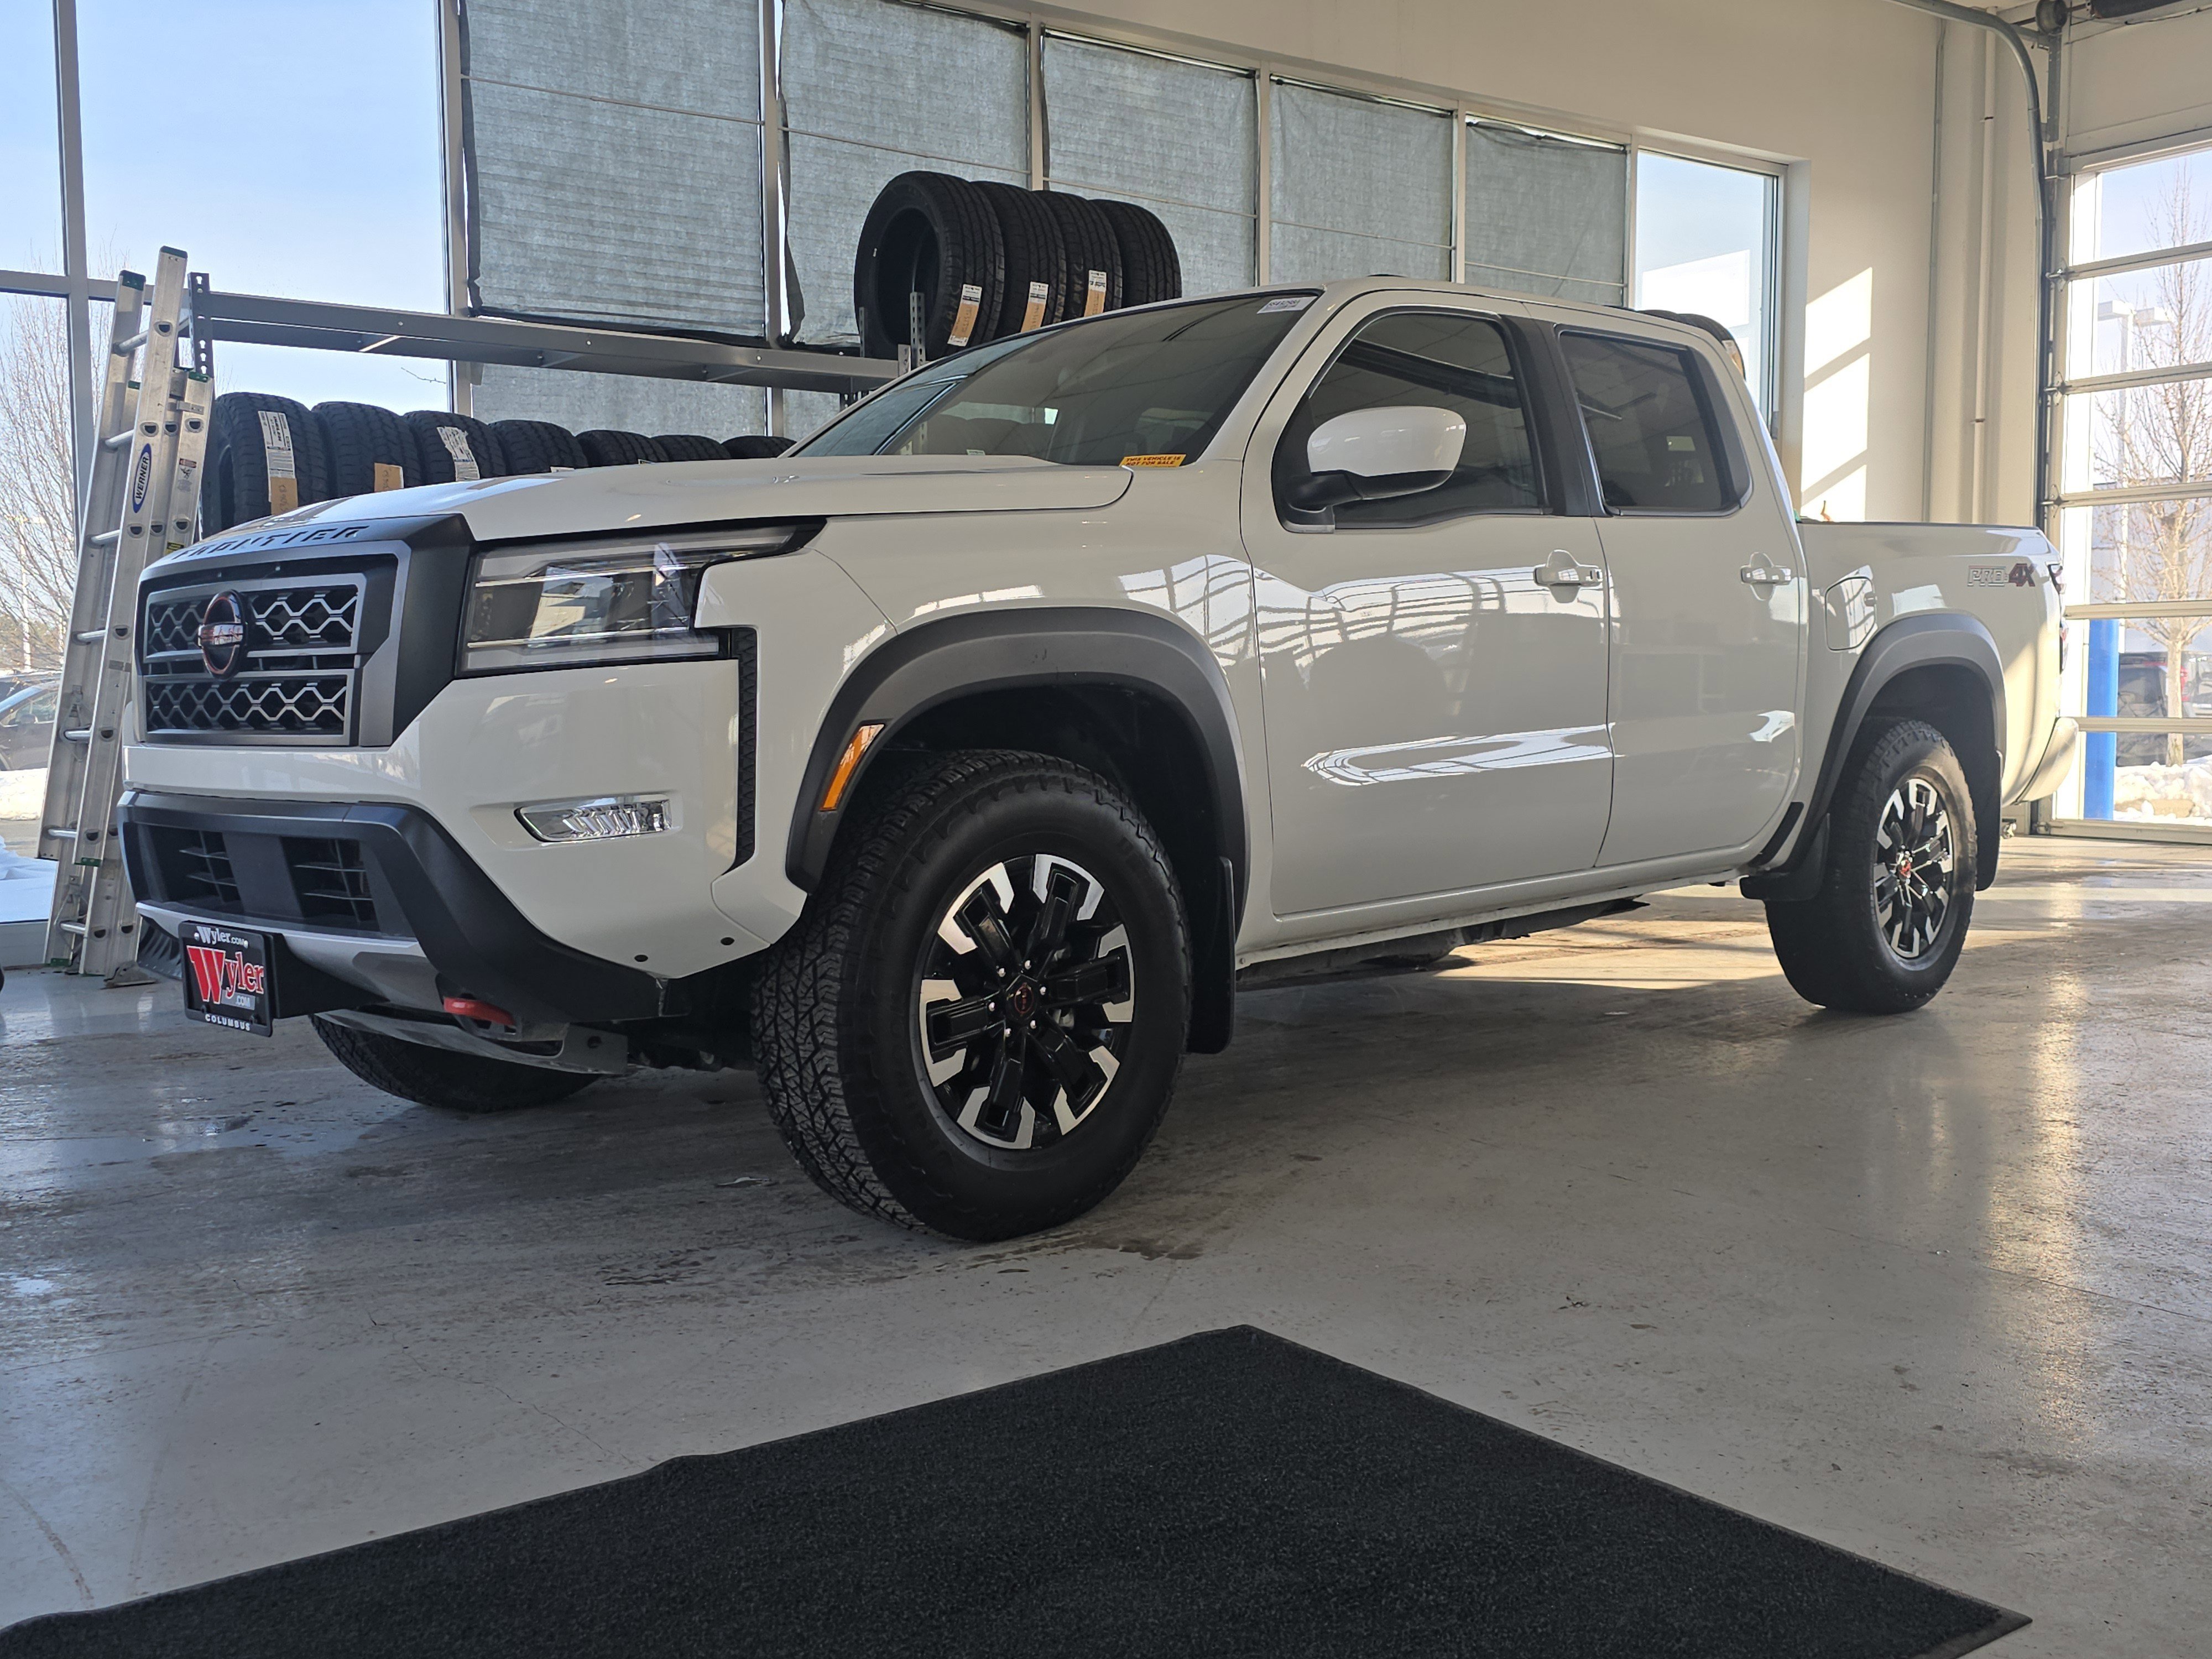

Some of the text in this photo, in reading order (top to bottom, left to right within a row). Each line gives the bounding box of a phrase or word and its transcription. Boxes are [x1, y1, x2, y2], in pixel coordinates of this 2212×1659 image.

[135, 456, 149, 499] WERNER
[171, 526, 369, 560] FRONTIER
[187, 945, 264, 1005] Wyler
[205, 1014, 250, 1031] COLUMBUS
